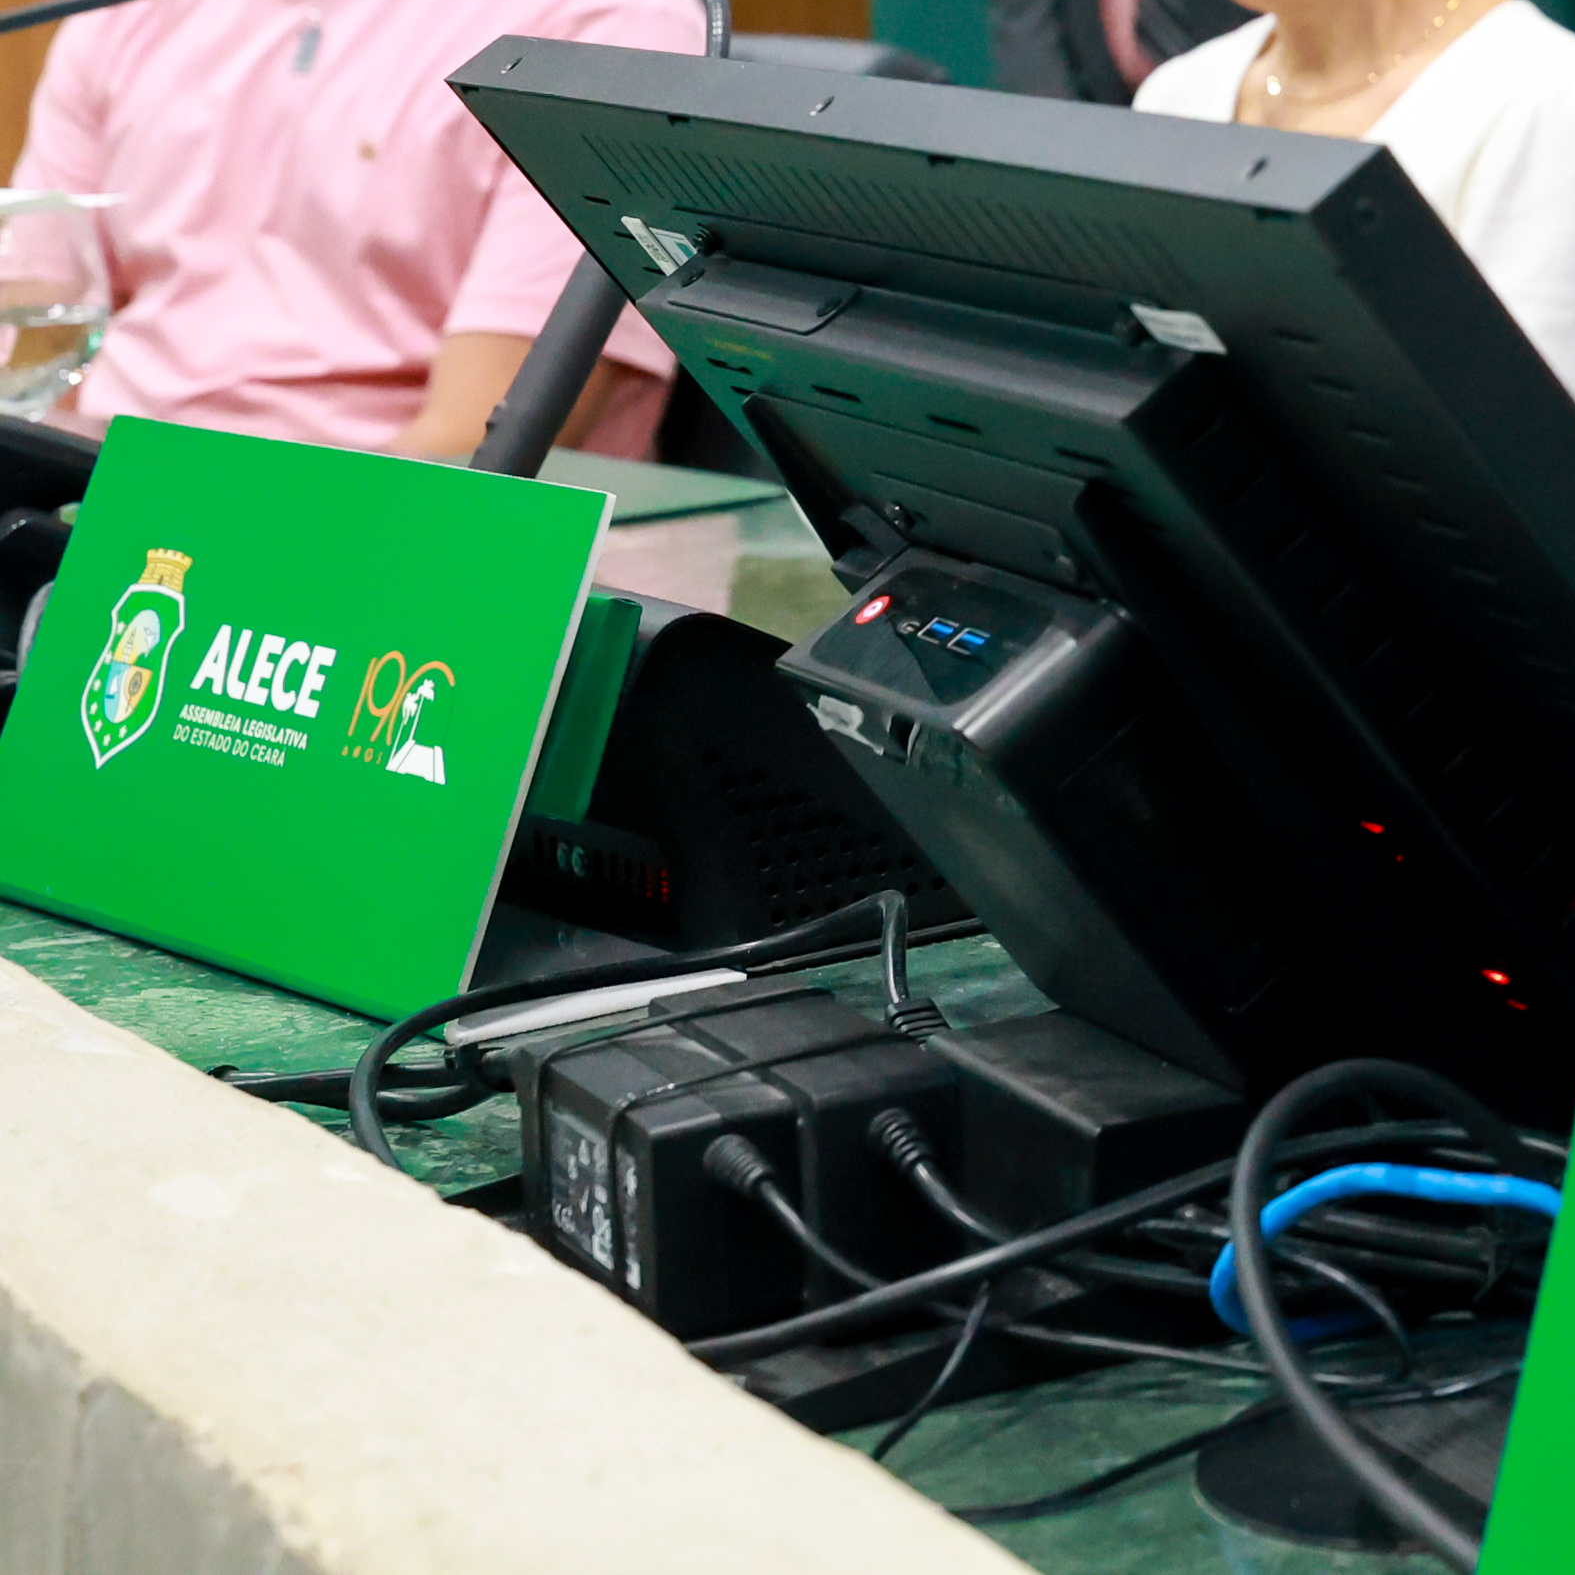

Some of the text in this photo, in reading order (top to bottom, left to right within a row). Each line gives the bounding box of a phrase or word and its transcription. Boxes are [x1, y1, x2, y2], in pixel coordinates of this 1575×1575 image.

[190, 624, 337, 718] ALECE
[173, 723, 287, 767] DO ESTADO DO CEARÁ
[179, 703, 308, 750] ASSEMBLEIA LEGISLATIVA
